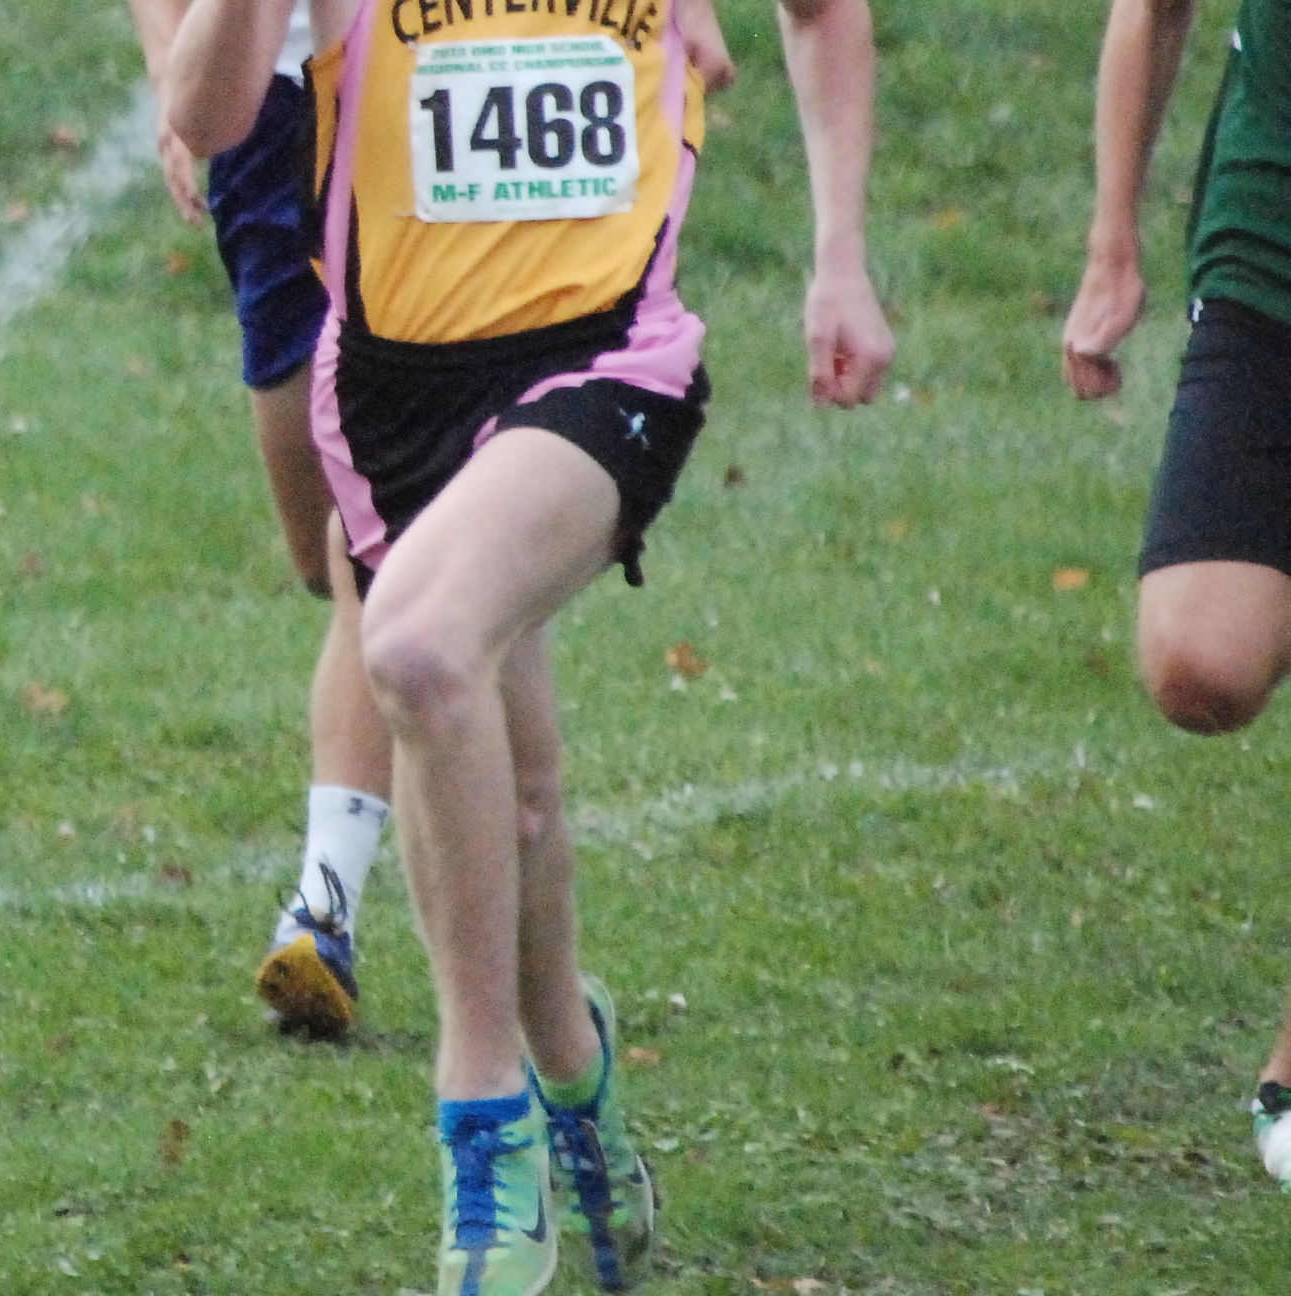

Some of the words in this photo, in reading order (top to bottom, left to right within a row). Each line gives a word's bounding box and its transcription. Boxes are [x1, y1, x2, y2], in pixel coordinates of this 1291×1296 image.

[418, 80, 628, 173] 1468
[431, 181, 483, 204] M-F
[493, 177, 618, 201] ATHLETIC
